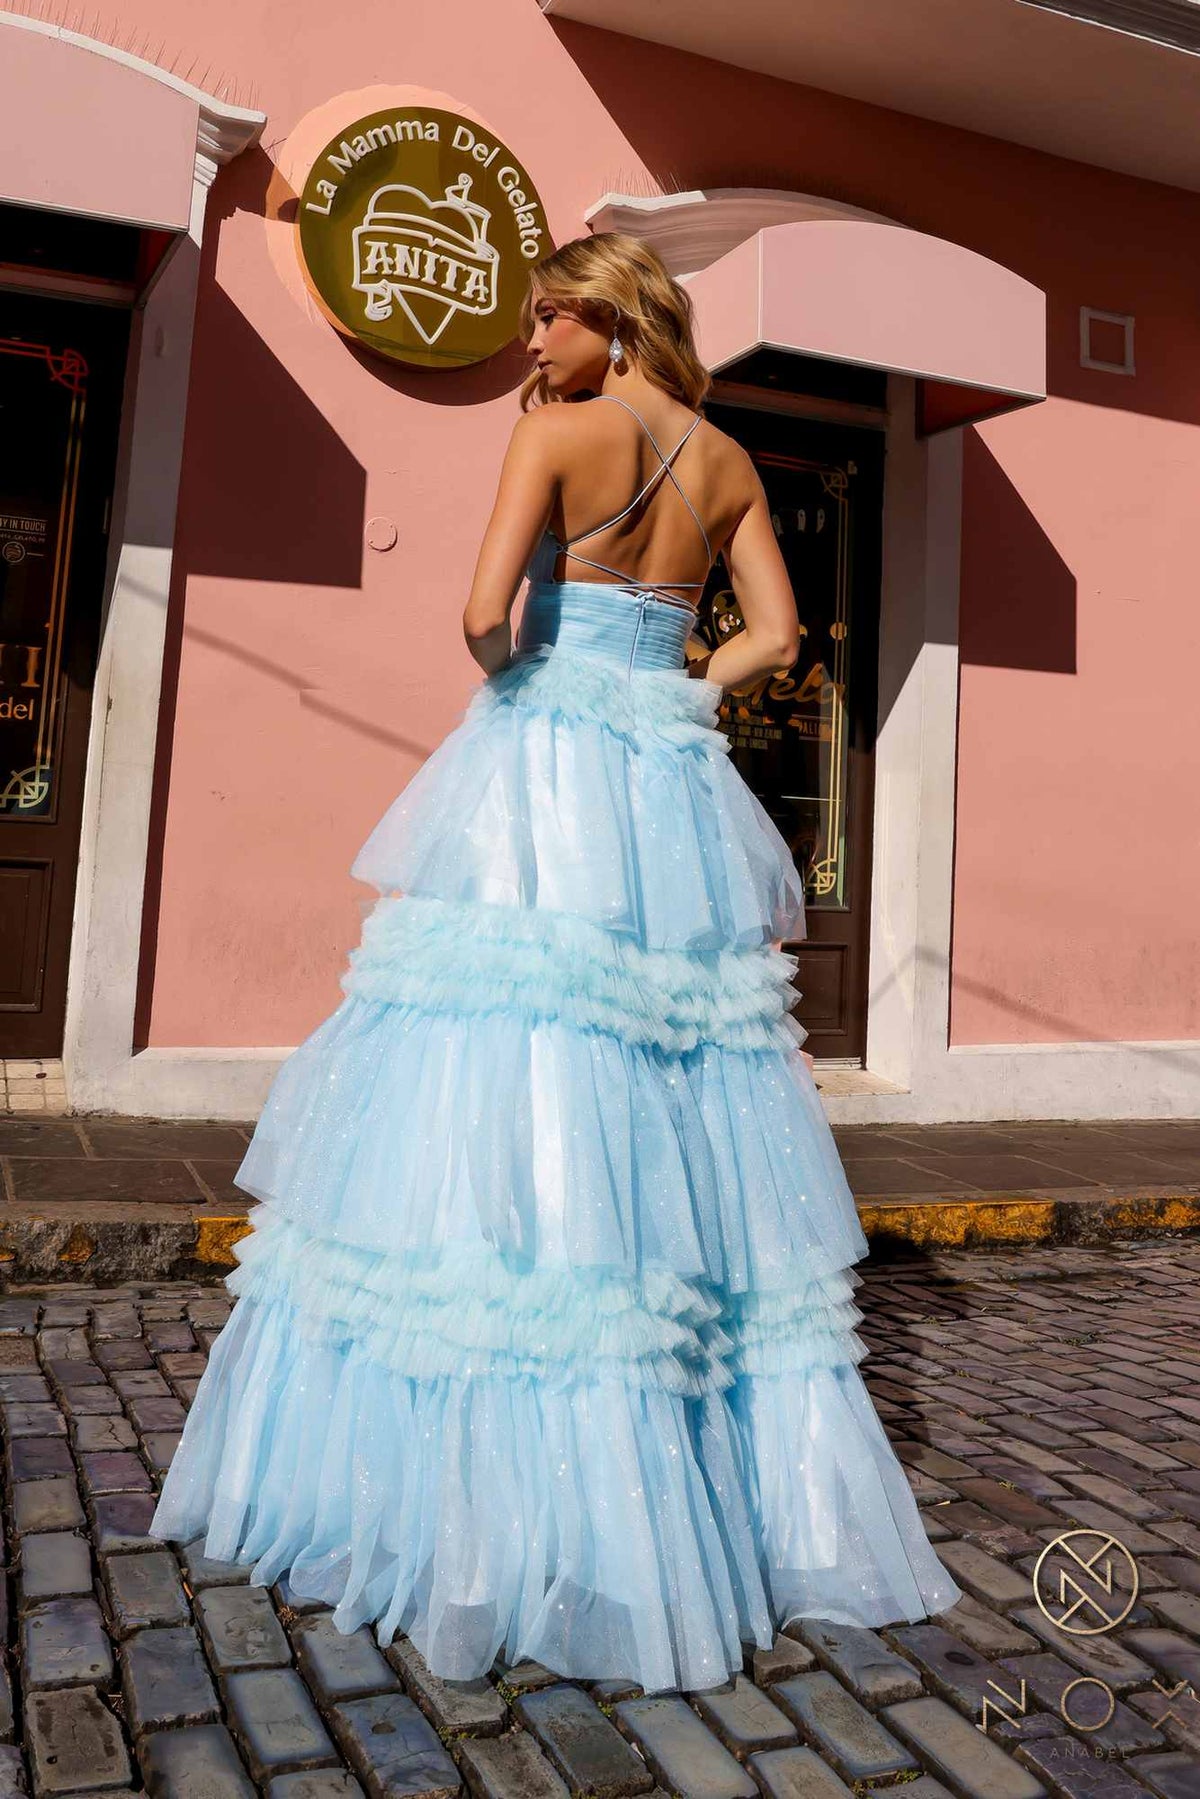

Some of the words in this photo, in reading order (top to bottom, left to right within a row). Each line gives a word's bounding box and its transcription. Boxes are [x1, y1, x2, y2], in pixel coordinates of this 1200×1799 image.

[305, 178, 338, 216] La
[327, 120, 440, 176] Mamma
[451, 124, 500, 168] Del
[497, 166, 543, 260] Gelato
[362, 240, 490, 303] ANITA
[10, 519, 18, 529] IN
[20, 520, 46, 532] TOUCH
[0, 696, 34, 720] del
